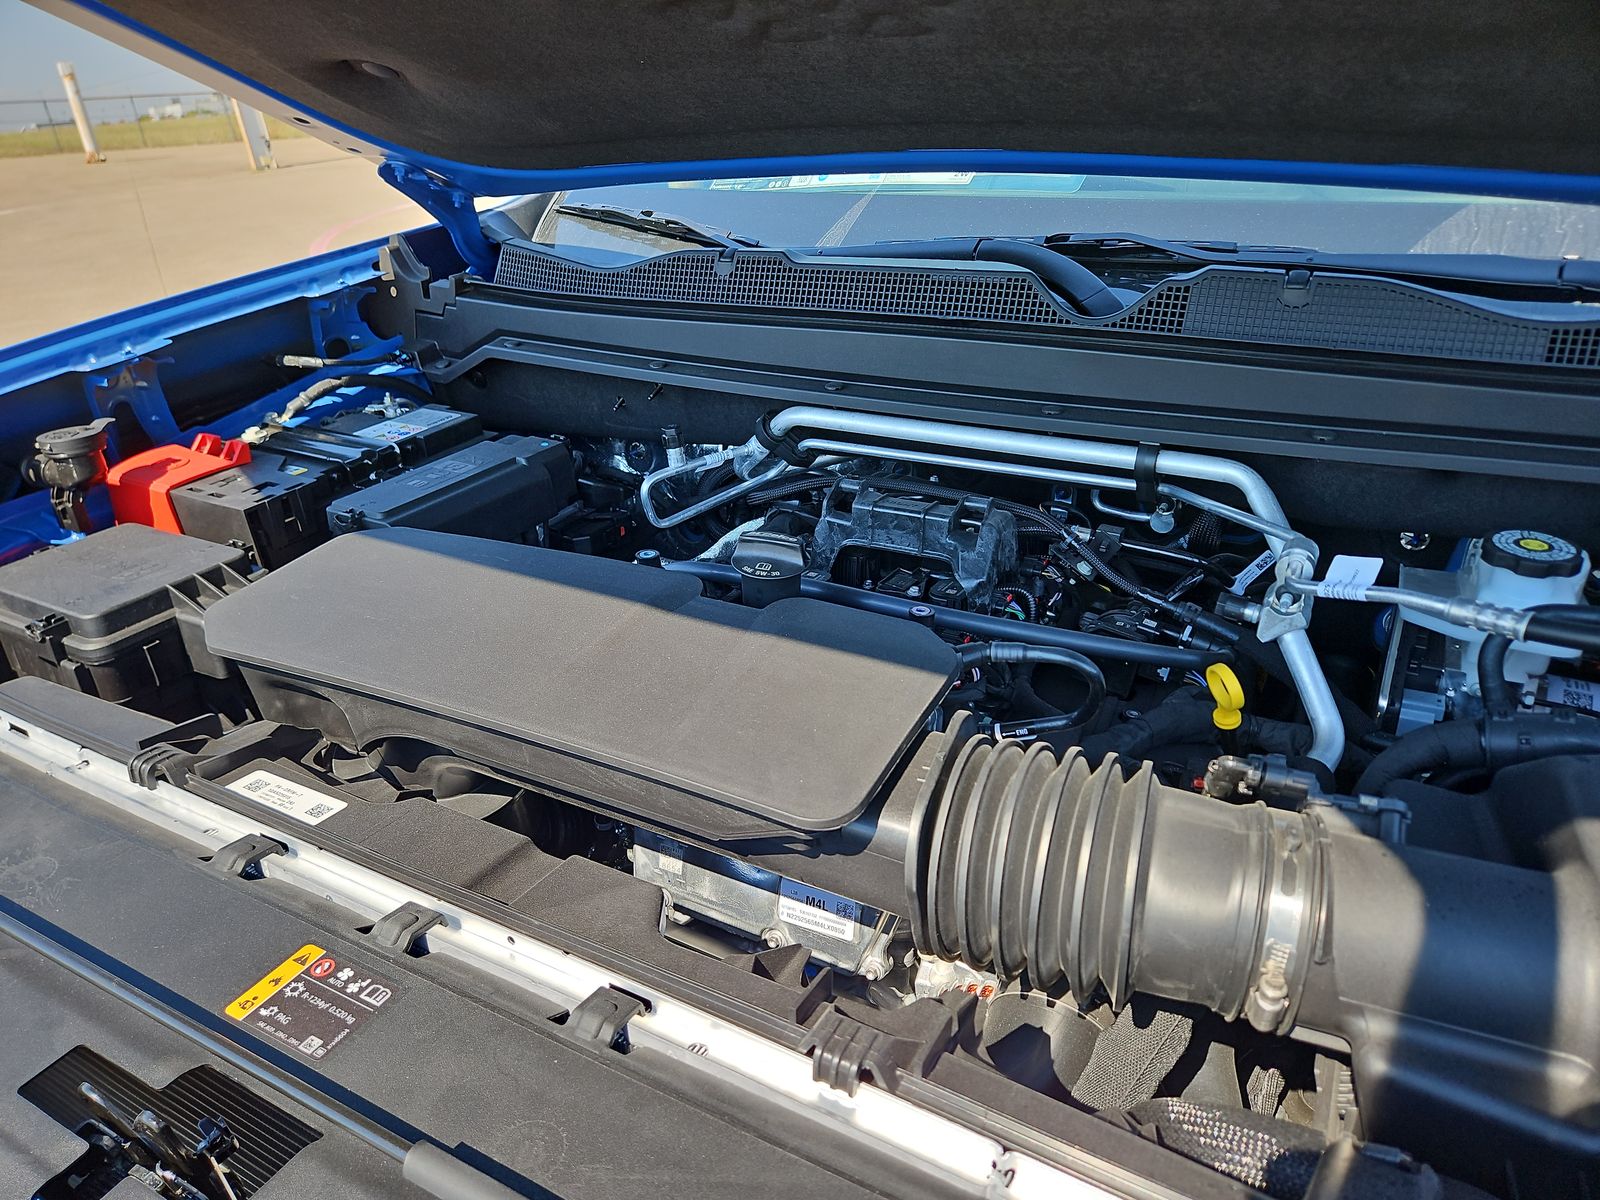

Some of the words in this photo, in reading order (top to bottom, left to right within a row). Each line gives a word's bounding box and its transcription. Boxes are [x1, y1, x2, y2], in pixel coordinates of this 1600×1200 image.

[742, 565, 754, 573] SAE
[805, 895, 829, 911] M4L
[327, 977, 344, 987] AUTO
[301, 991, 332, 1009] R-1234yf
[328, 1006, 348, 1019] 0.520
[345, 1014, 356, 1024] kg
[274, 1011, 292, 1025] PAG
